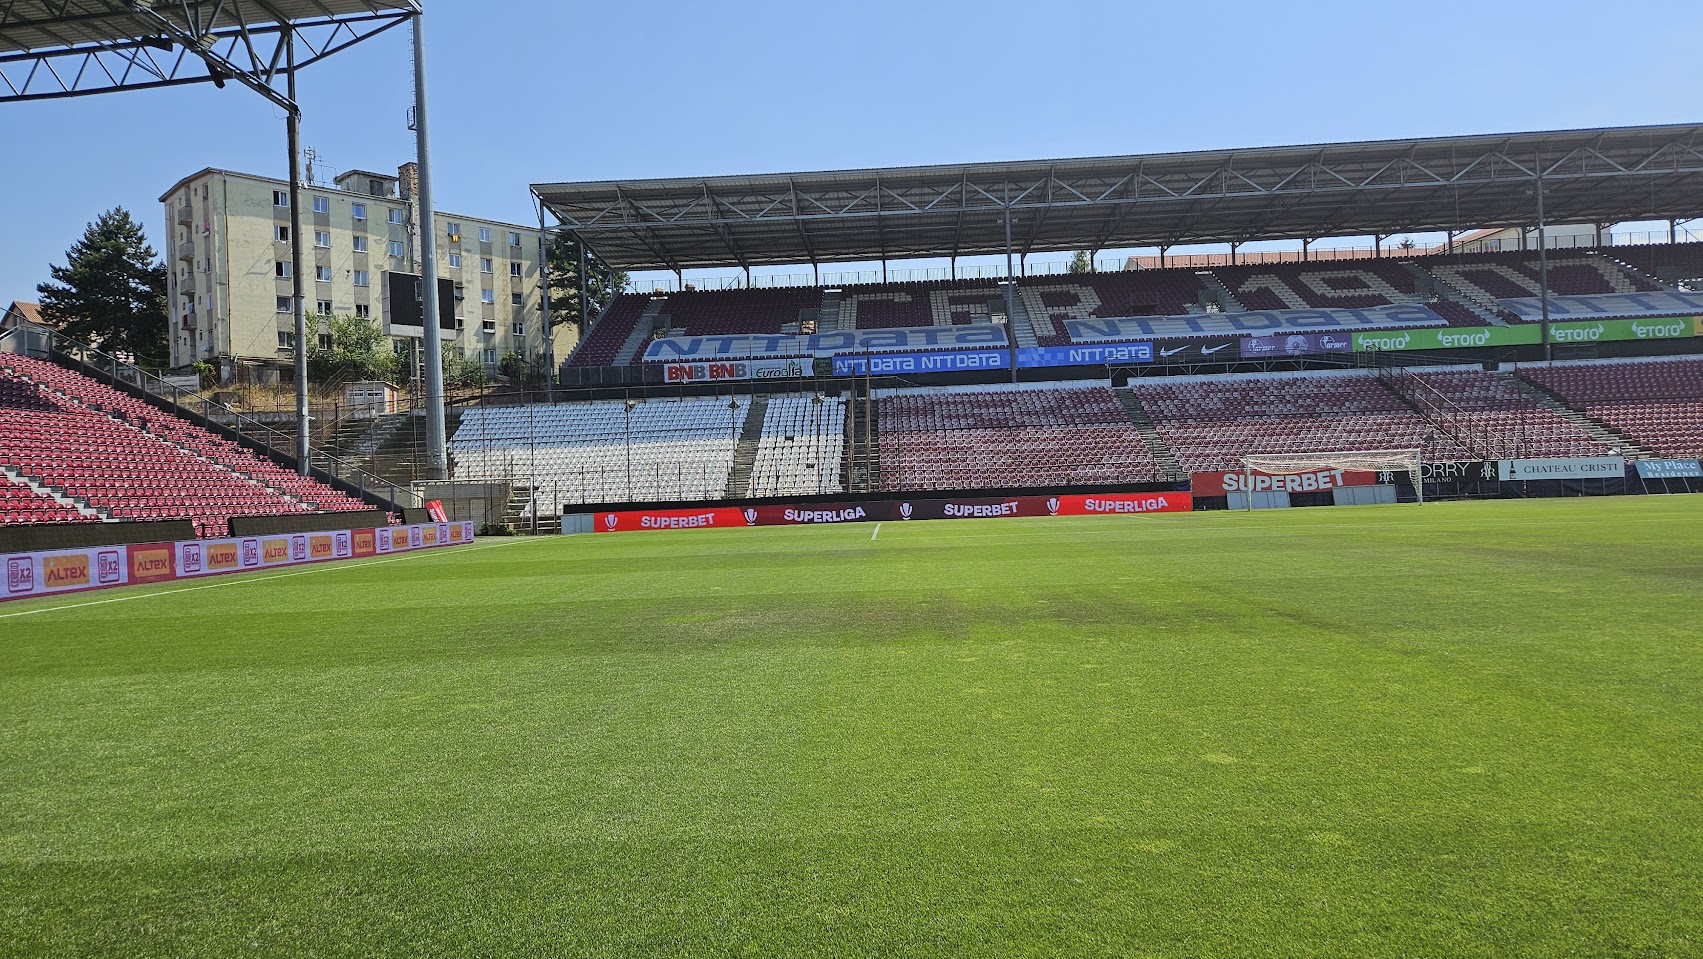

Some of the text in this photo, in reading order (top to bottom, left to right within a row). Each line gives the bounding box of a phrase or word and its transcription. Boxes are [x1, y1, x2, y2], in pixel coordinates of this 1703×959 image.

[1066, 315, 1212, 338] NTT
[646, 335, 797, 357] NTT
[921, 355, 955, 369] NTT
[1069, 348, 1103, 362] NTT
[667, 363, 748, 380] BNB BNB
[836, 359, 867, 373] NTT
[1523, 463, 1618, 475] CHATEAU CRISTI
[1643, 460, 1697, 472] My Place
[1222, 469, 1345, 492] SUPERBET
[1423, 476, 1452, 484] MILANO
[944, 501, 1019, 517] SUPERBET
[1085, 496, 1169, 513] SUPERLIGA
[641, 512, 715, 528] SUPERBET
[784, 506, 866, 523] SUPERLIGA
[19, 567, 32, 580] X2
[107, 560, 118, 572] X2
